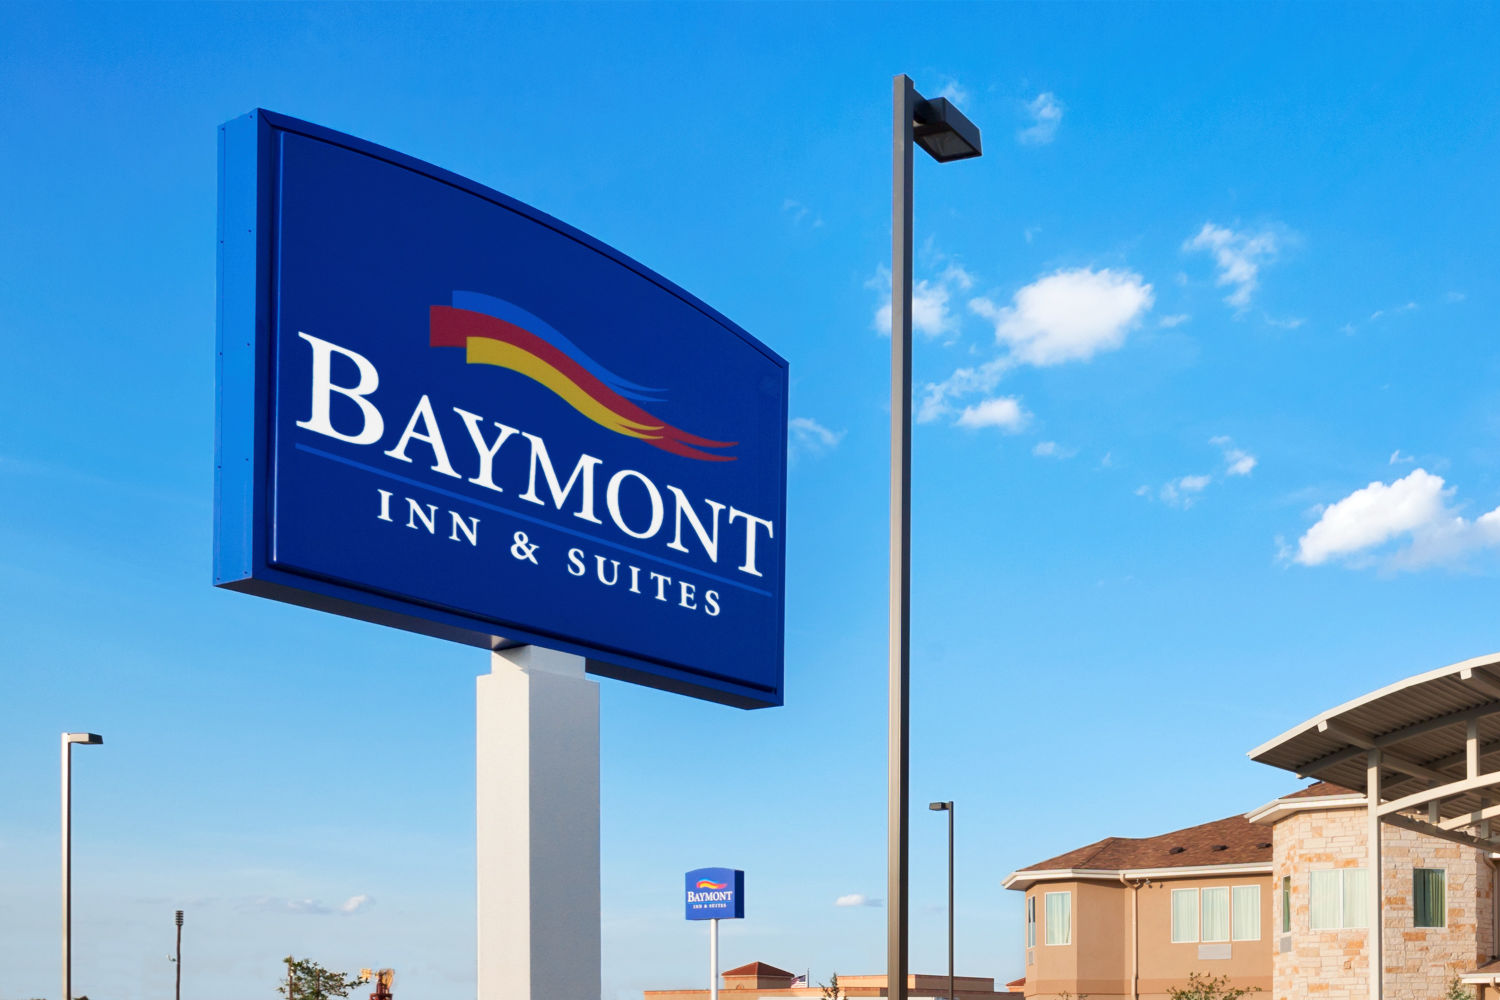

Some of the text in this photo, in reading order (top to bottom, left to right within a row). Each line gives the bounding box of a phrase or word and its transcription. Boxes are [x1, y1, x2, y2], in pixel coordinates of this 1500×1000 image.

[296, 331, 774, 578] BAYMONT
[377, 489, 721, 617] INN & SUITES
[688, 891, 732, 902] BAYMONT
